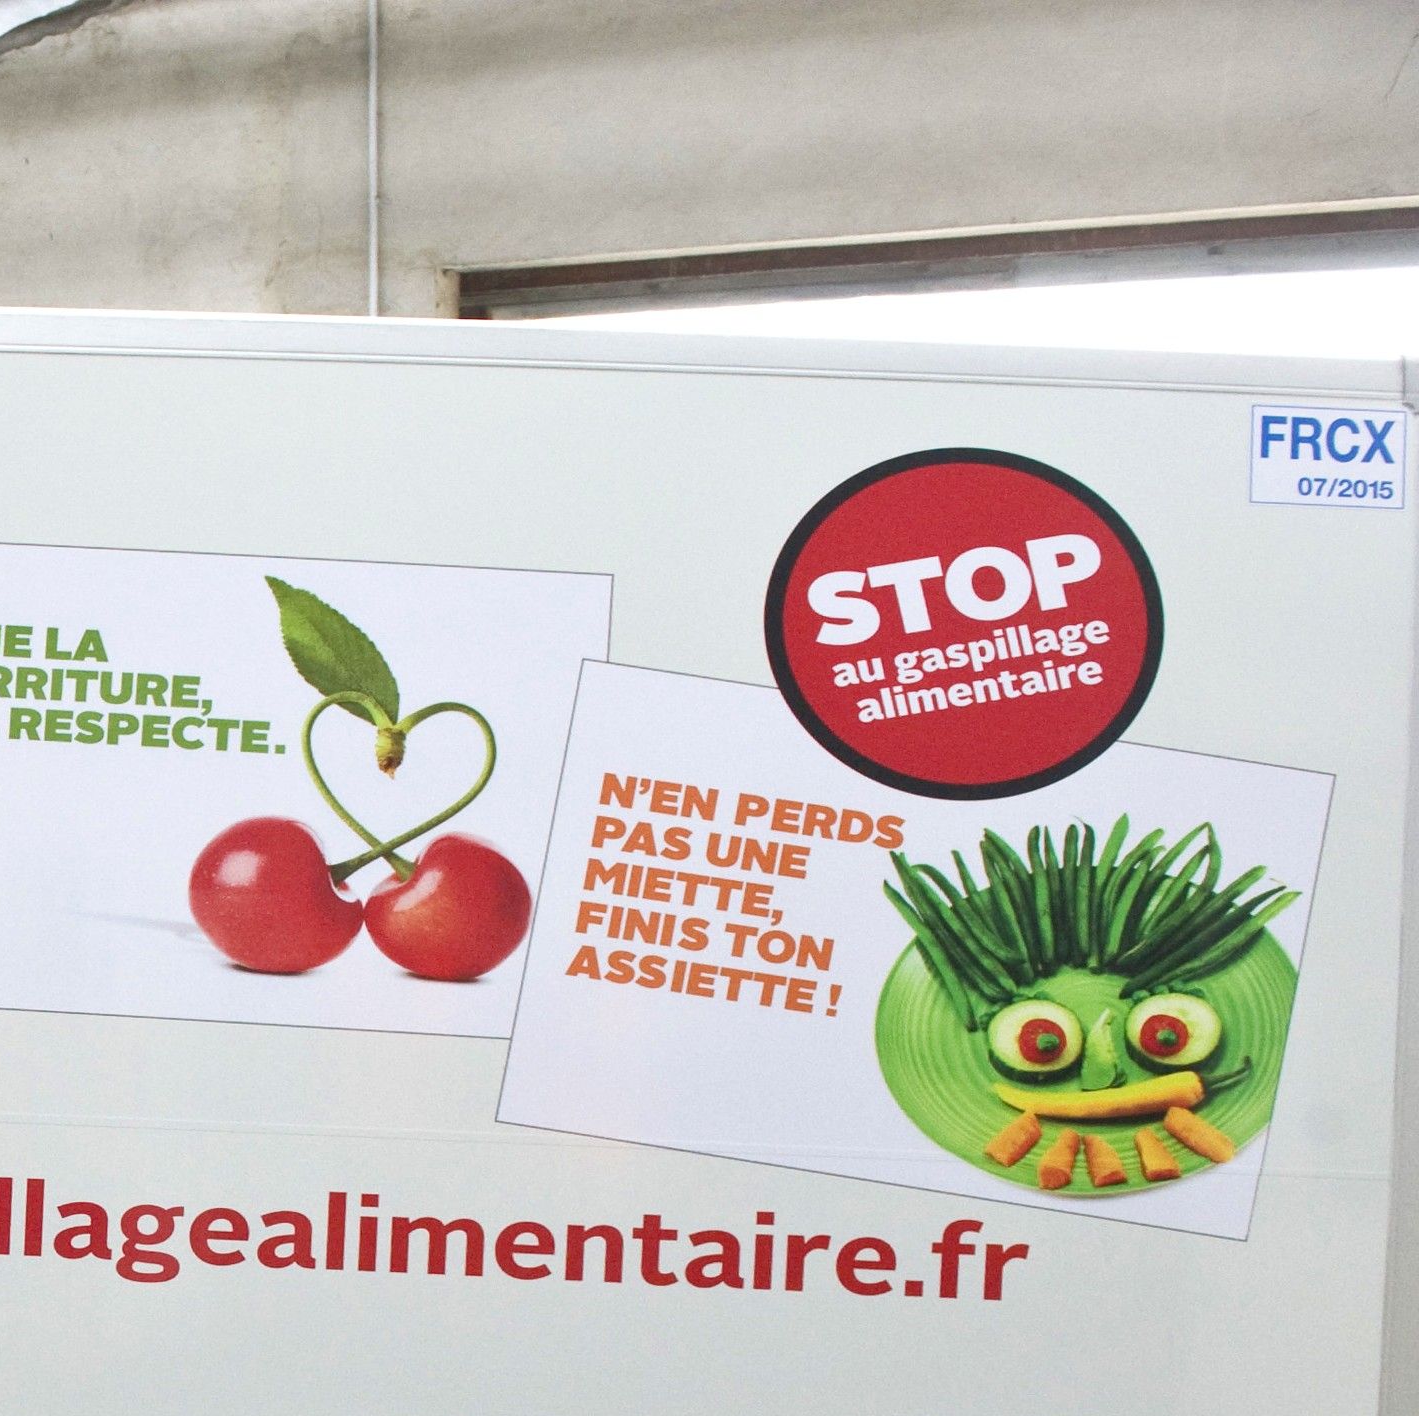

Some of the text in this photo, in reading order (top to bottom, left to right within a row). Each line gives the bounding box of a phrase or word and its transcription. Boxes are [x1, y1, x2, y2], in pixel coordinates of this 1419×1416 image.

[1259, 414, 1396, 465] FRCX
[1297, 475, 1394, 501] 07/2015
[806, 533, 1102, 647] STOP
[45, 627, 108, 663] LA
[832, 615, 1110, 688] au gaspillage
[856, 656, 1103, 725] alimentaire
[8, 706, 286, 755] RESPECTE.
[597, 772, 906, 851] N'EN PERDS
[589, 815, 811, 880] PAS UNE
[582, 858, 785, 929] MIETTE,
[574, 900, 835, 973] FINIS TON
[565, 944, 822, 1014] ASSIETTE
